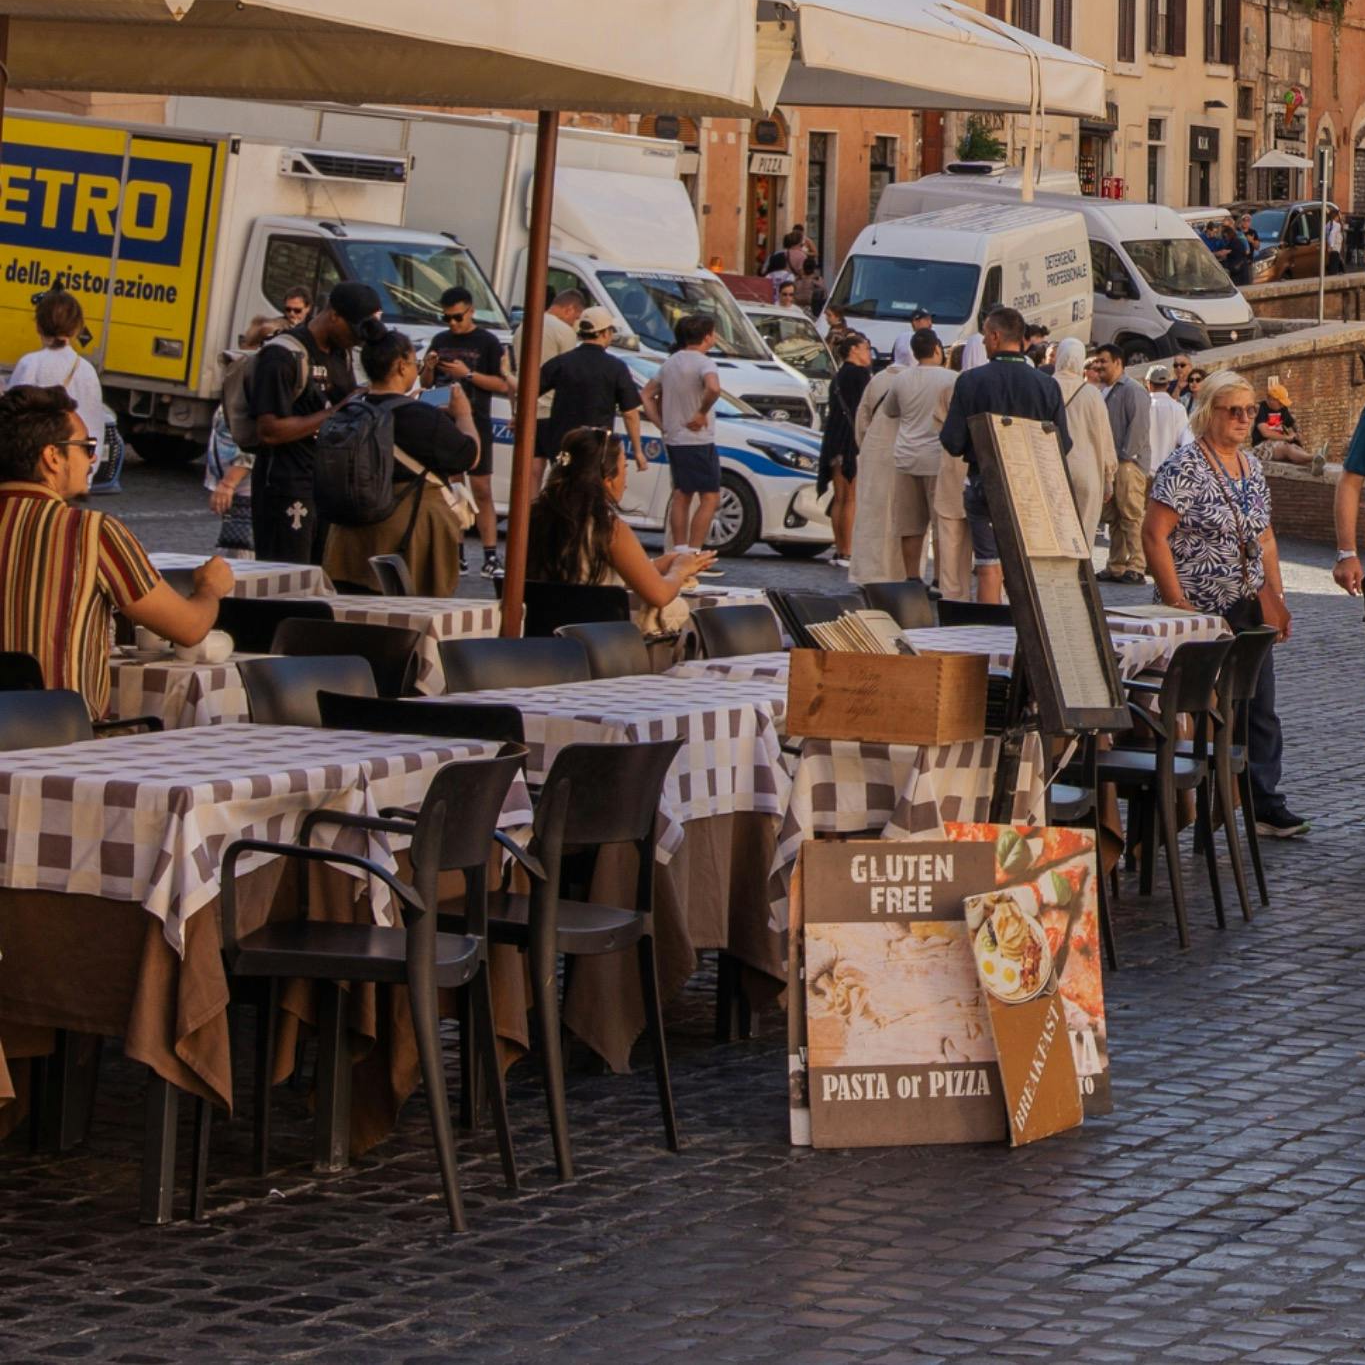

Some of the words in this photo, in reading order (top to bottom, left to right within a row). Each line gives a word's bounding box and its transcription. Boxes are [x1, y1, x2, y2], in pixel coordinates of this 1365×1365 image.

[760, 157, 783, 173] PIZZA
[6, 258, 50, 286] della
[56, 265, 177, 303] ristorazione
[851, 854, 954, 883] GLUTEN
[870, 885, 932, 914] FREE
[1014, 1000, 1060, 1132] BREAKFAST
[822, 1072, 890, 1101] PASTA
[897, 1075, 922, 1099] or
[928, 1069, 992, 1098] PIZZA
